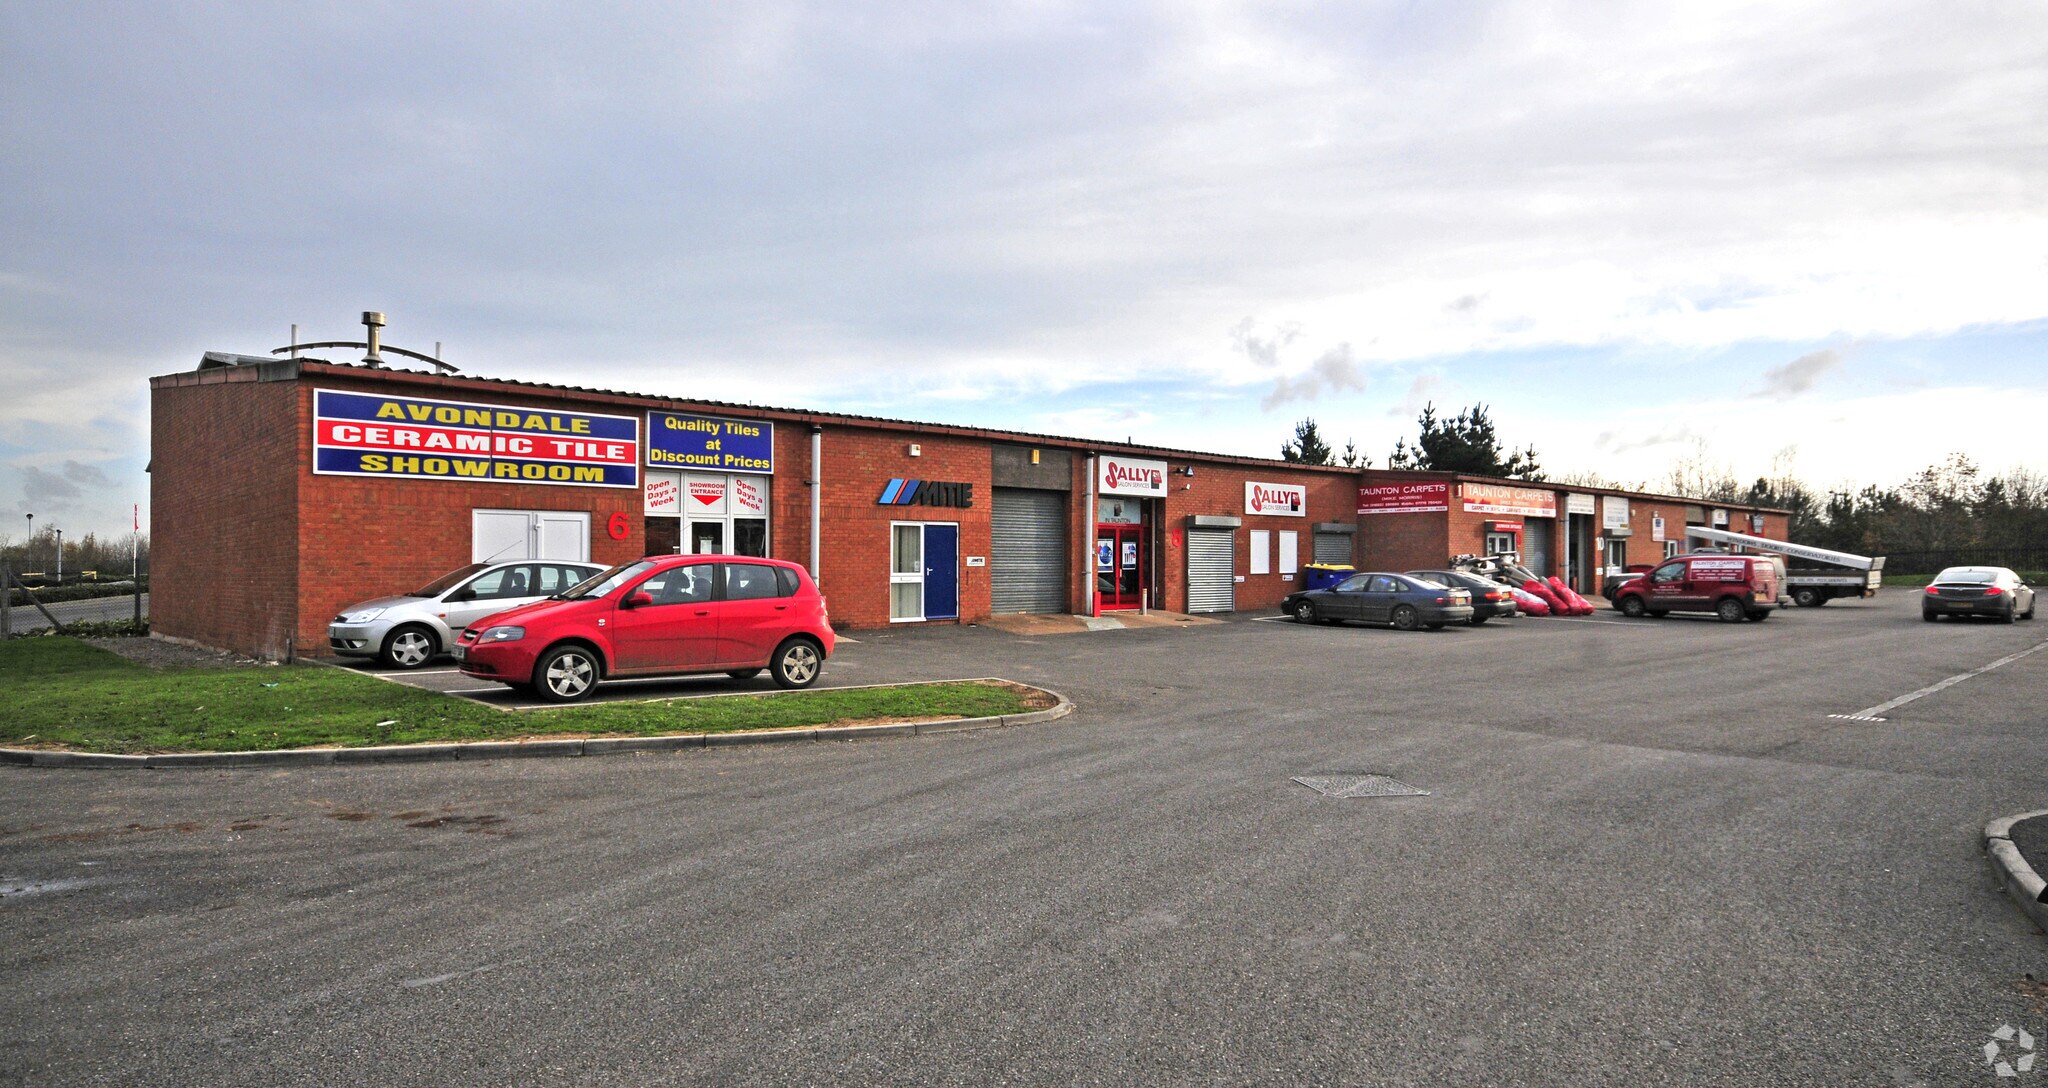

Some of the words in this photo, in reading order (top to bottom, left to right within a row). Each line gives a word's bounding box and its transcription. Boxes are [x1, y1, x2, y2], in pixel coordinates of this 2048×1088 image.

[376, 402, 591, 434] AVONDALE
[665, 416, 720, 436] Quality
[724, 422, 760, 437] Tiles
[332, 425, 533, 454] CERAMIC
[550, 440, 626, 460] TILE
[705, 439, 721, 450] at
[651, 448, 720, 466] Discount
[724, 454, 770, 469] Prices
[360, 455, 604, 482] SHOWROOM
[1105, 461, 1151, 489] SALLY
[646, 480, 670, 491] Open
[736, 479, 757, 493] Open
[736, 488, 756, 501] Days
[911, 480, 973, 508] MITIE
[1359, 486, 1400, 496] TAUNTON
[1403, 484, 1446, 494] CARPETS
[1467, 485, 1511, 499] TAUNTON
[1514, 490, 1553, 502] CARPETS
[647, 490, 669, 500] Days
[650, 496, 675, 508] Week
[738, 497, 761, 511] Week
[1251, 484, 1290, 512] SALLY
[608, 511, 630, 541] 6
[1172, 527, 1183, 547] 8
[1596, 537, 1605, 551] 10
